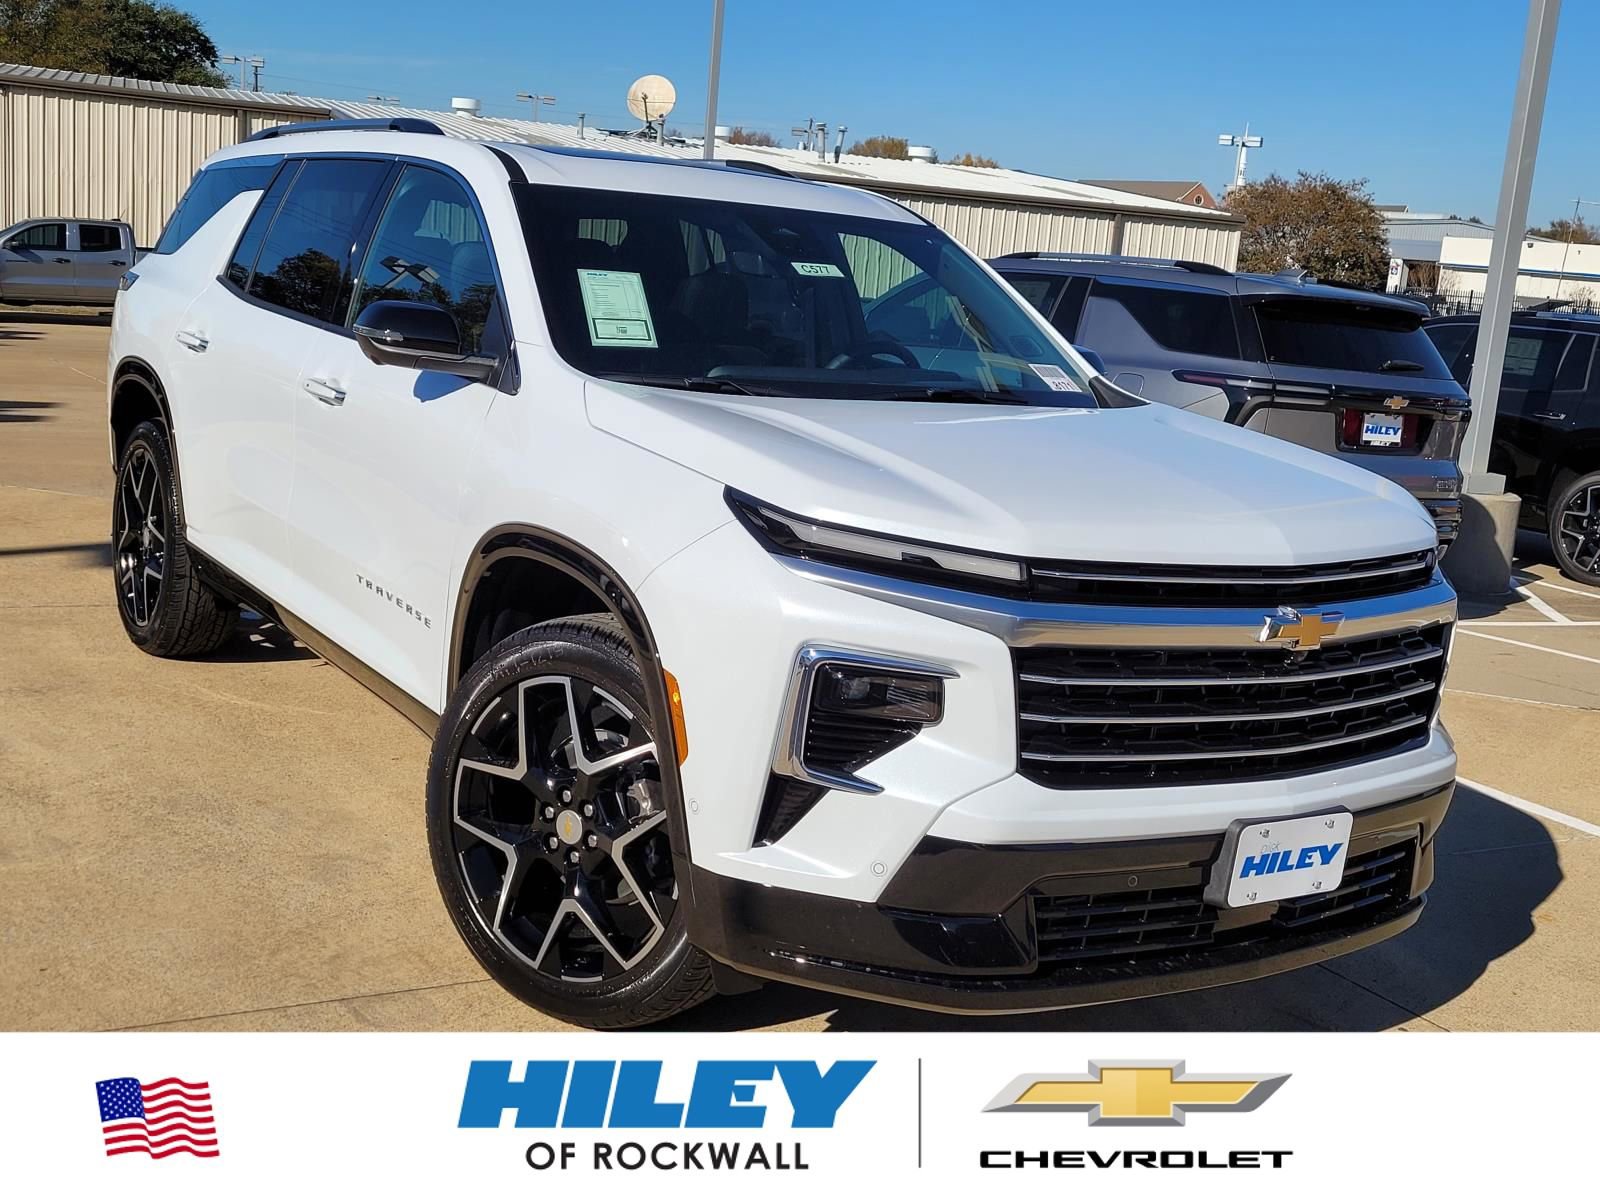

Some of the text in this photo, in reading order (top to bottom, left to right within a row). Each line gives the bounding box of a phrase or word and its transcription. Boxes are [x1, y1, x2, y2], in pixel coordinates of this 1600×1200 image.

[801, 265, 830, 274] C577
[1364, 425, 1401, 436] HILEY
[356, 573, 432, 629] TRAVERSE
[1239, 842, 1344, 879] HILEY
